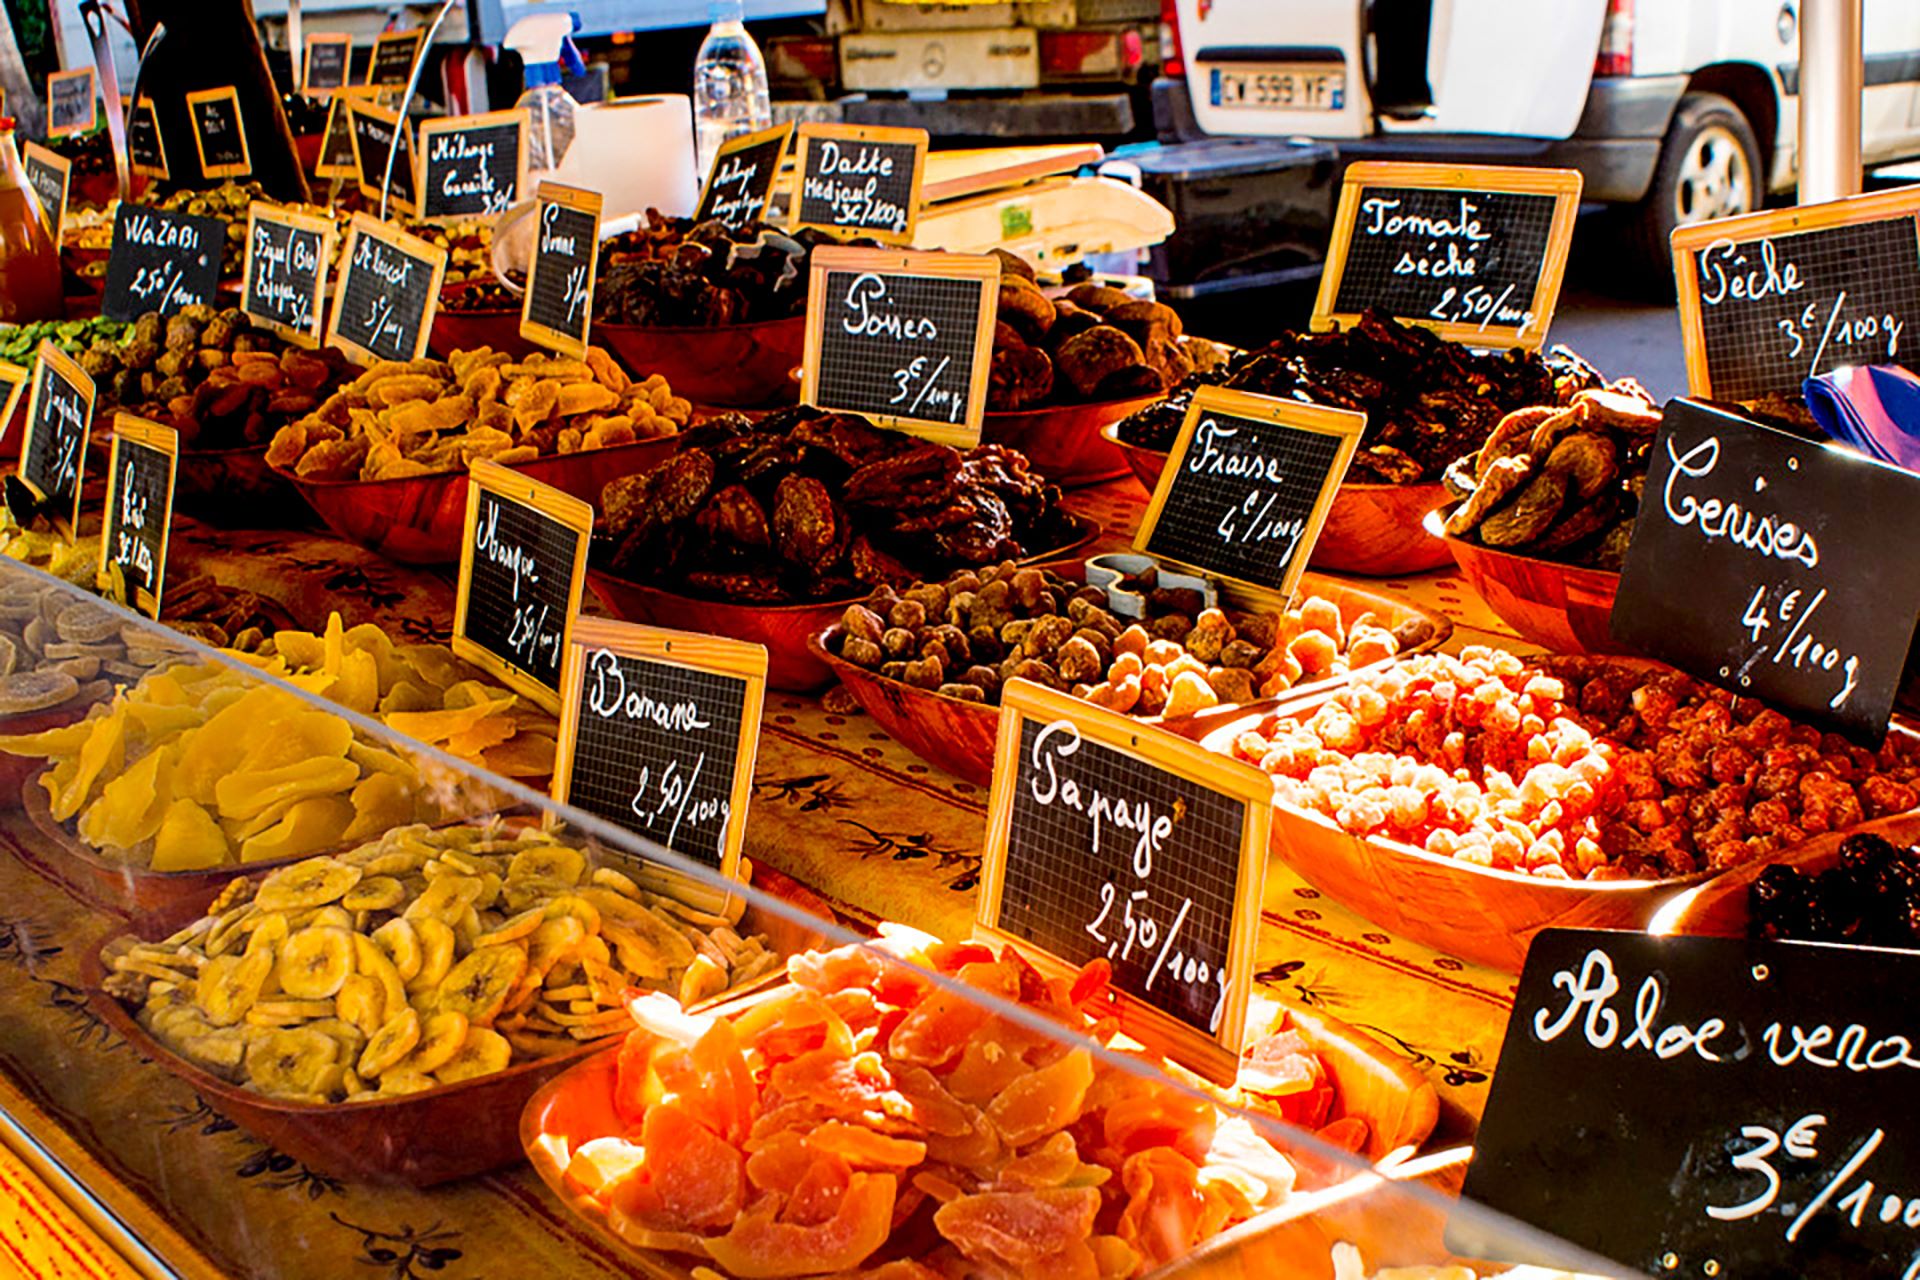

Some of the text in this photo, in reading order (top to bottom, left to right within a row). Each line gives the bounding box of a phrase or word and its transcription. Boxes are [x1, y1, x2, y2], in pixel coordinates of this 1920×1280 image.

[820, 141, 893, 175] Datte
[843, 273, 937, 340] Poires
[1701, 238, 1804, 305] Pêche
[1189, 418, 1284, 483] Fraise
[1663, 432, 1819, 568] Cerises
[590, 648, 710, 731] Banane
[1032, 719, 1172, 879] Papaye
[1534, 948, 1920, 1073] Aloe vera
